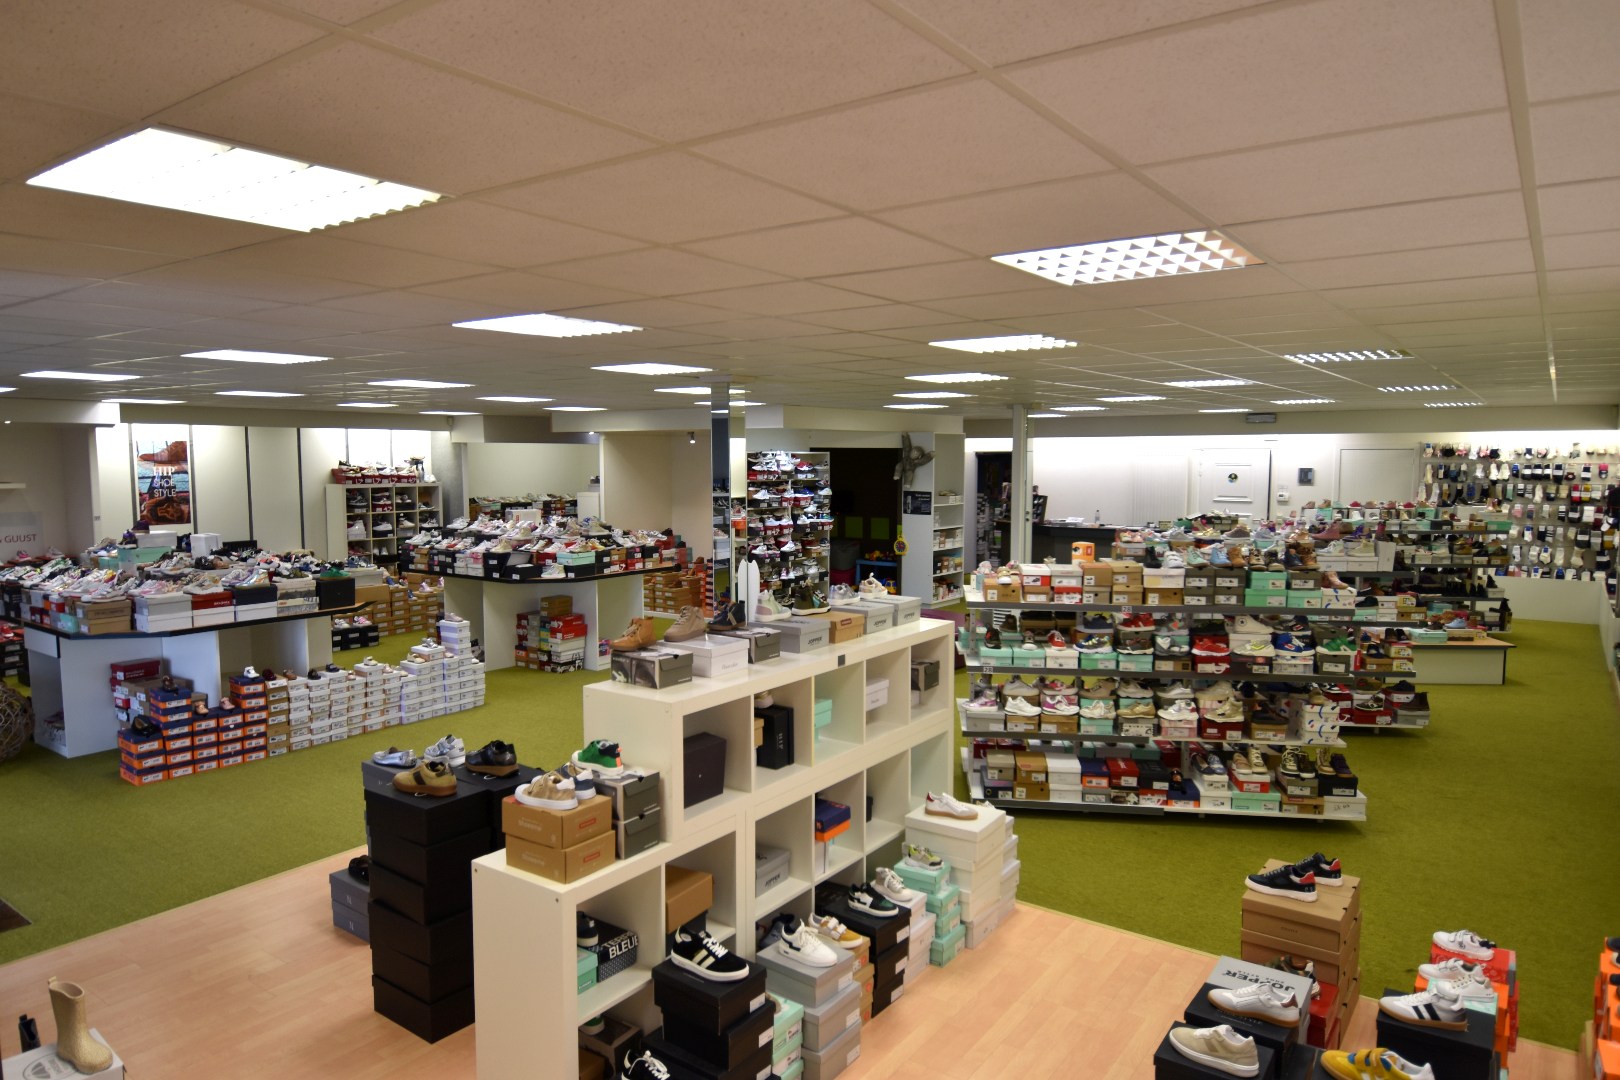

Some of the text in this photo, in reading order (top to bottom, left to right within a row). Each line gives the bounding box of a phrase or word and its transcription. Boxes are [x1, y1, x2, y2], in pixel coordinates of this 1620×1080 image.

[152, 466, 175, 476] HIP
[154, 479, 175, 487] SHOE
[154, 489, 177, 497] STYLE
[4, 533, 37, 543] GUUST
[608, 935, 638, 959] BLEUE
